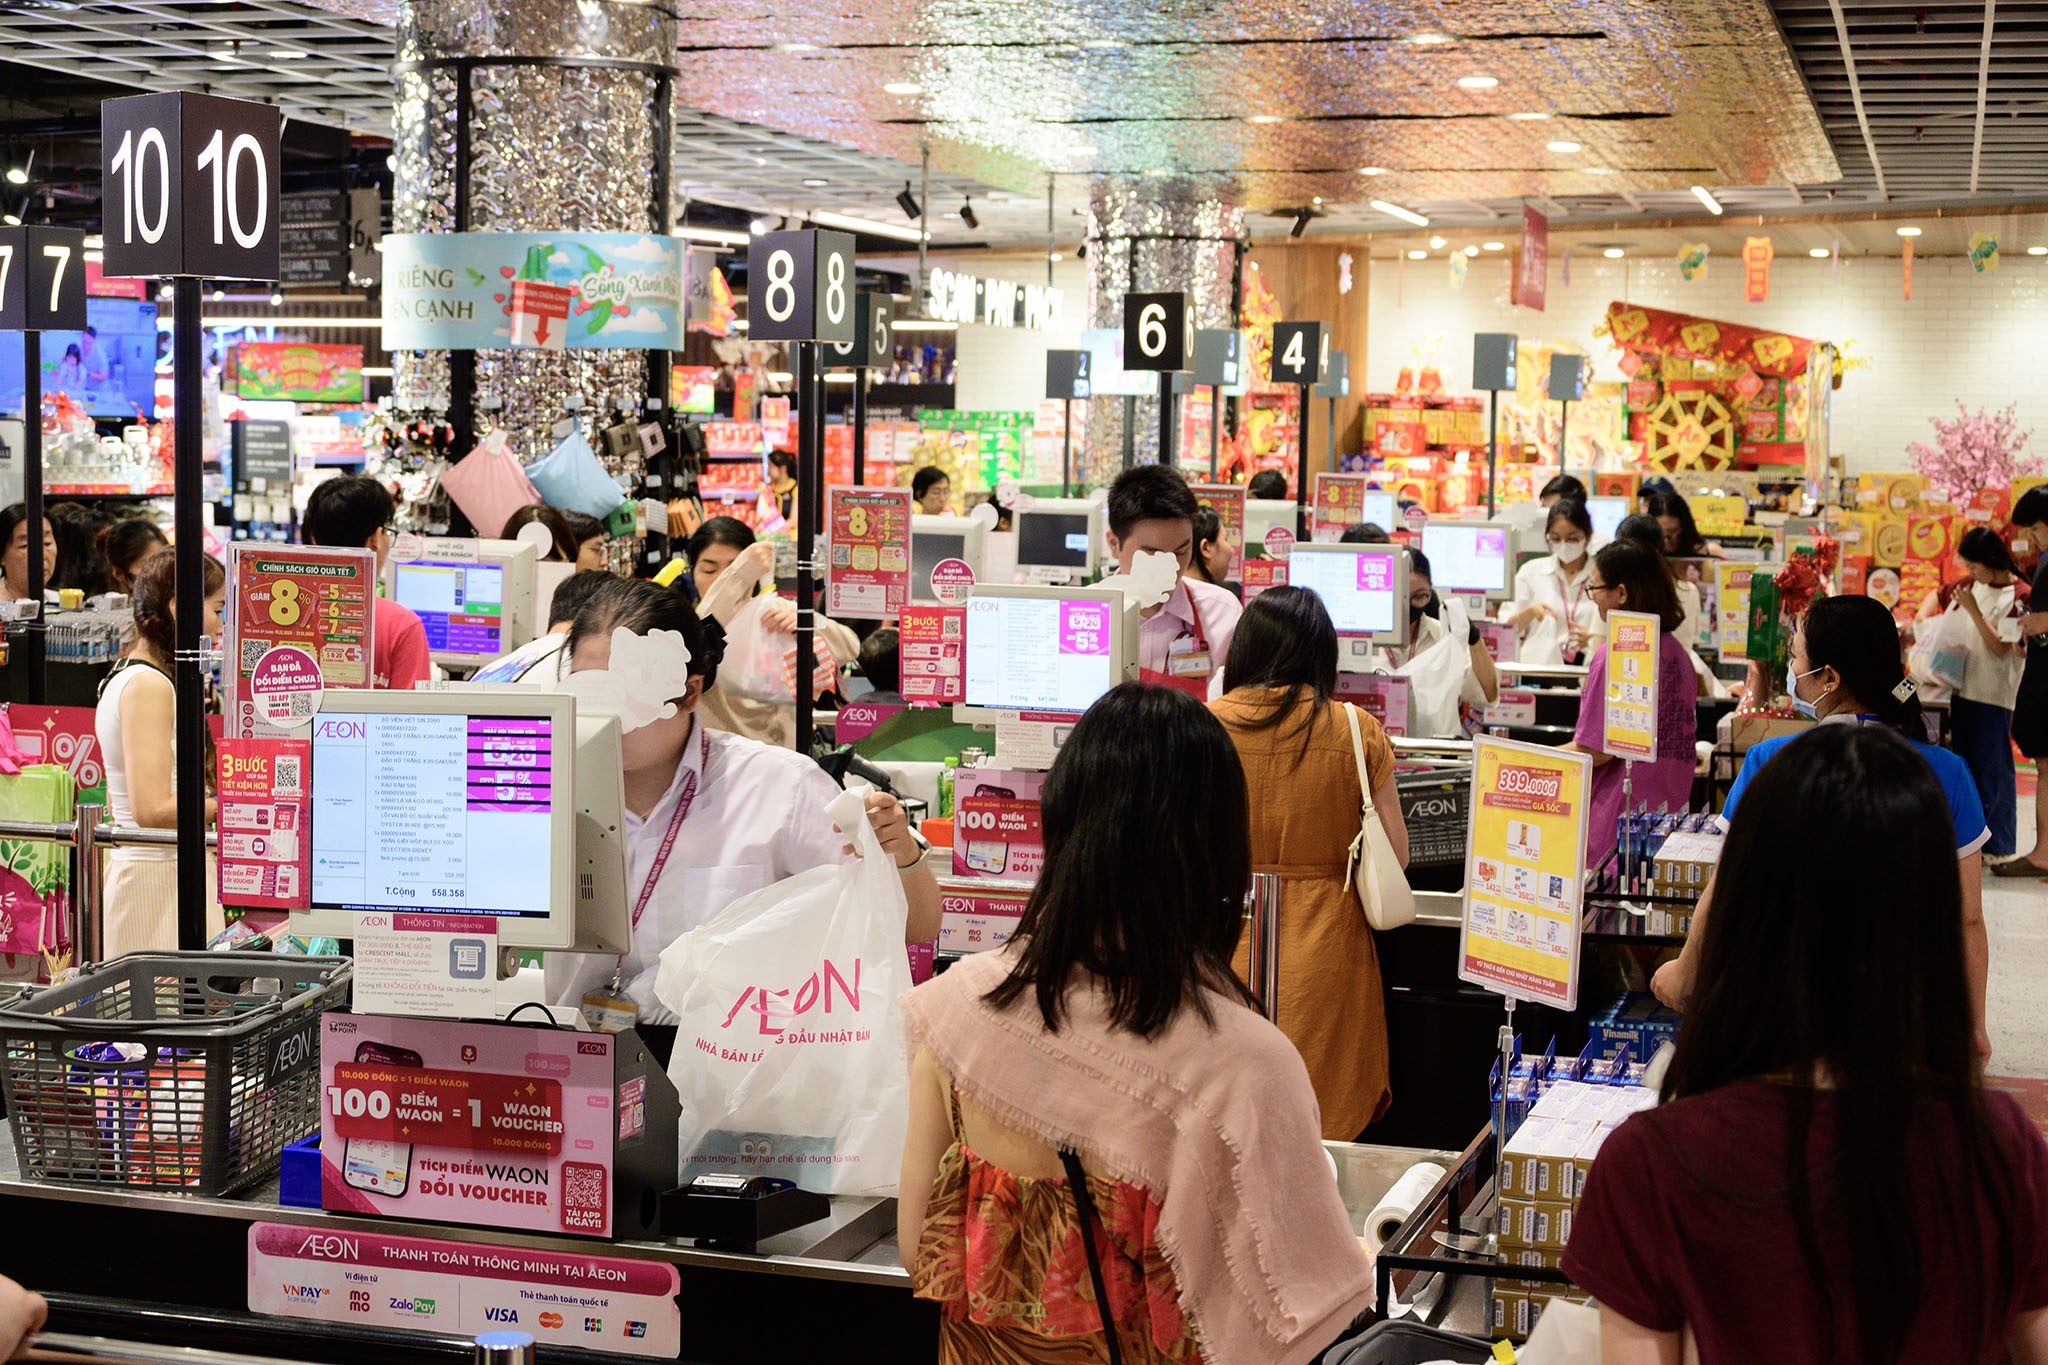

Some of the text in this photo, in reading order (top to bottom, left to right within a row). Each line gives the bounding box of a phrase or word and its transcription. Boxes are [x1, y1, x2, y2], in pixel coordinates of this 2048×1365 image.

[111, 127, 169, 244] 10
[197, 129, 267, 249] 10
[43, 245, 70, 312] 7
[765, 249, 795, 322] 8
[826, 251, 845, 325] 8
[874, 306, 888, 355] 5
[1138, 303, 1167, 357] 6
[1185, 305, 1194, 358] 6
[1281, 331, 1306, 375] 4
[1320, 332, 1329, 375] 4
[849, 507, 867, 536] 8
[262, 563, 284, 572] CHÍNH
[285, 564, 304, 574] SÁCH
[338, 565, 350, 576] TẾT
[902, 615, 938, 629] 3 BƯỚC
[270, 661, 302, 675] BẠN ĐÃ
[255, 673, 317, 686] ĐỔI ĐIỂM CHƯA
[268, 709, 290, 718] WAON
[221, 753, 268, 778] 3 BƯỚC
[221, 778, 268, 791] TIẾT KIỆM HƠN
[1498, 769, 1558, 798] 399.000đ
[1532, 801, 1545, 811] GIÁ
[1545, 801, 1561, 813] SỐC
[957, 811, 1024, 830] 100 ĐIỂM
[998, 822, 1027, 830] WAON
[385, 887, 465, 898] T.Cộng 558.358
[989, 903, 1017, 912] THANH
[402, 917, 430, 928] THÔNG
[432, 919, 445, 928] TIN
[383, 981, 408, 990] KHÔNG
[1603, 1028, 1639, 1040] Vinamilk
[695, 1037, 717, 1056] NHÀ
[721, 1045, 748, 1063] BÁN
[788, 1027, 815, 1044] ĐẦU
[820, 1029, 853, 1048] NHẬT
[856, 1026, 870, 1043] BẢN
[341, 1070, 369, 1080] 10.000
[371, 1071, 398, 1083] ĐỒNG
[414, 1074, 436, 1086] ĐIỂM
[439, 1079, 469, 1088] WAON
[327, 1086, 391, 1120] 100
[401, 1090, 437, 1108] ĐIỂM
[468, 1098, 481, 1128] 1
[503, 1102, 551, 1117] WAON
[396, 1108, 563, 1134] WAON VOUCHER
[492, 1137, 551, 1150] 10.000 ĐỒNG
[742, 1154, 757, 1166] hãy
[760, 1155, 775, 1165] hạn
[809, 1155, 831, 1167] dụng
[420, 1158, 548, 1185] TÍCH ĐIỂM WAON
[419, 1174, 548, 1206] ĐỔI VOUCHER
[566, 1206, 600, 1219] TẢI APP
[566, 1216, 602, 1228] NGAY!!
[382, 1246, 428, 1262] THANH
[432, 1250, 469, 1266] TOÁN
[472, 1255, 520, 1271] THÔNG
[524, 1261, 560, 1275] MINH
[563, 1265, 584, 1280] TẠI
[589, 1268, 627, 1282] AEON
[352, 1272, 366, 1283] điện
[367, 1274, 378, 1283] tử
[389, 1297, 435, 1315] ZaloPay
[519, 1290, 609, 1308] Thẻ thanh toán quốc tế
[483, 1306, 519, 1324] VISA
